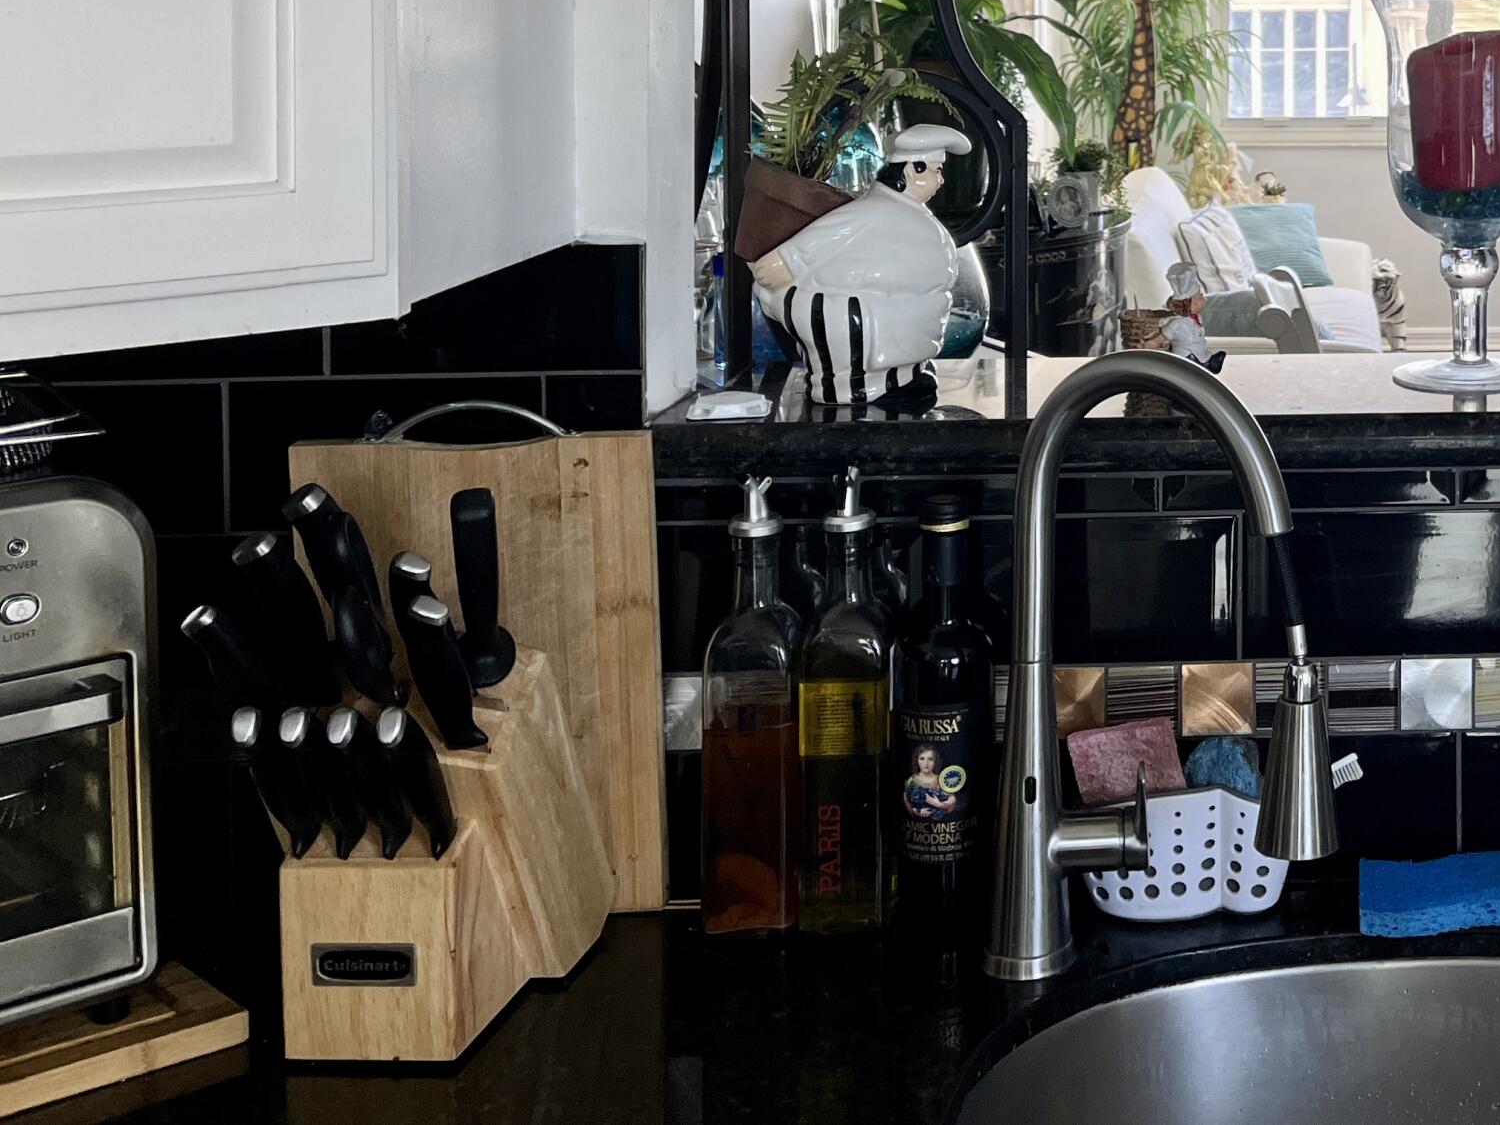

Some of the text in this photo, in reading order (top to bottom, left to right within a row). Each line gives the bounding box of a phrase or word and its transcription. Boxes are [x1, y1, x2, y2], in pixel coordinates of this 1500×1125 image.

[0, 559, 38, 572] POWER
[2, 629, 37, 643] LIGHT
[912, 832, 963, 845] MODENA
[818, 804, 841, 895] PARIS
[323, 959, 399, 971] Cuisinart
